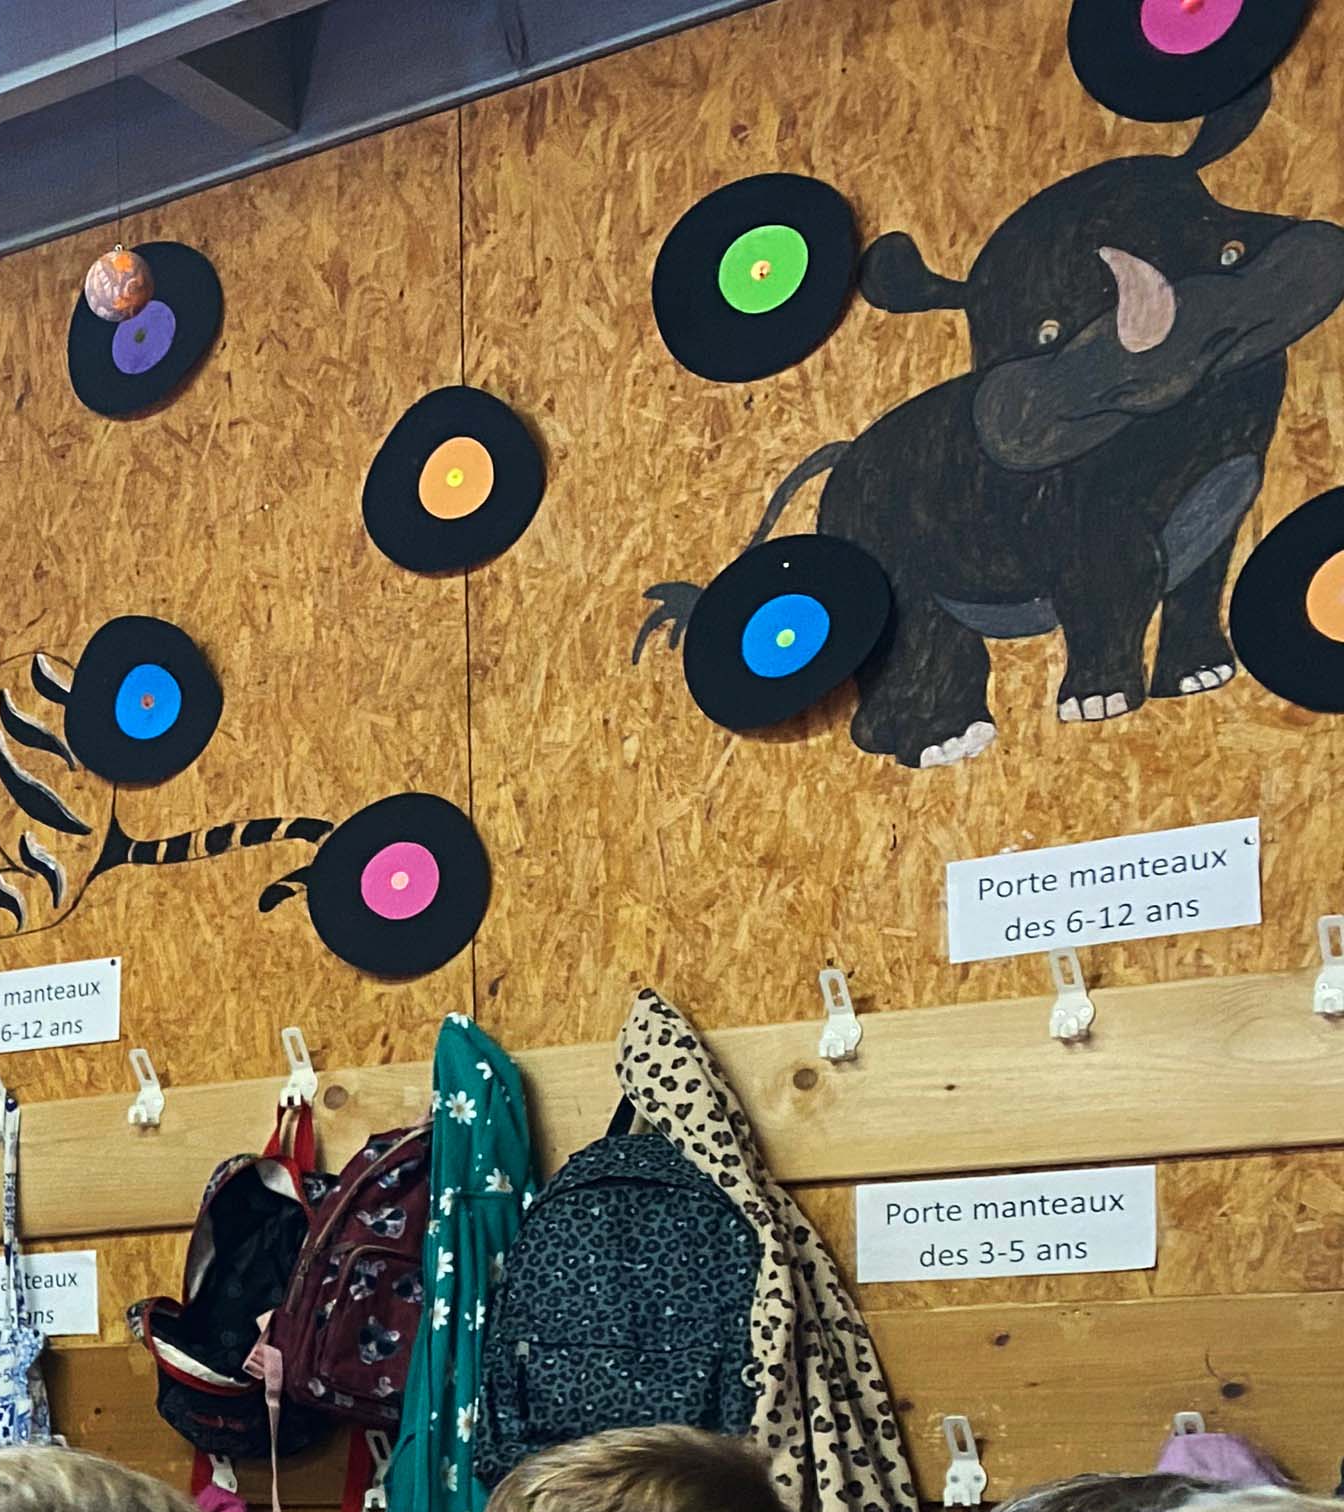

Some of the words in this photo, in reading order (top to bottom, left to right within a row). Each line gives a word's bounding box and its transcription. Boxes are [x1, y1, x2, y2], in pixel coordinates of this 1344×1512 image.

[978, 873, 1058, 901] Porte
[1070, 846, 1228, 889] manteaux
[1004, 917, 1055, 942] des
[1066, 903, 1135, 934] 6-12
[1146, 898, 1200, 923] ans
[3, 981, 101, 1007] manteaux
[0, 1020, 43, 1042] 6-12
[49, 1017, 83, 1037] ans
[886, 1201, 963, 1226] Porte
[972, 1193, 1125, 1221] manteaux
[919, 1243, 970, 1268] des
[979, 1239, 1026, 1266] 3-5
[1036, 1240, 1089, 1262] ans
